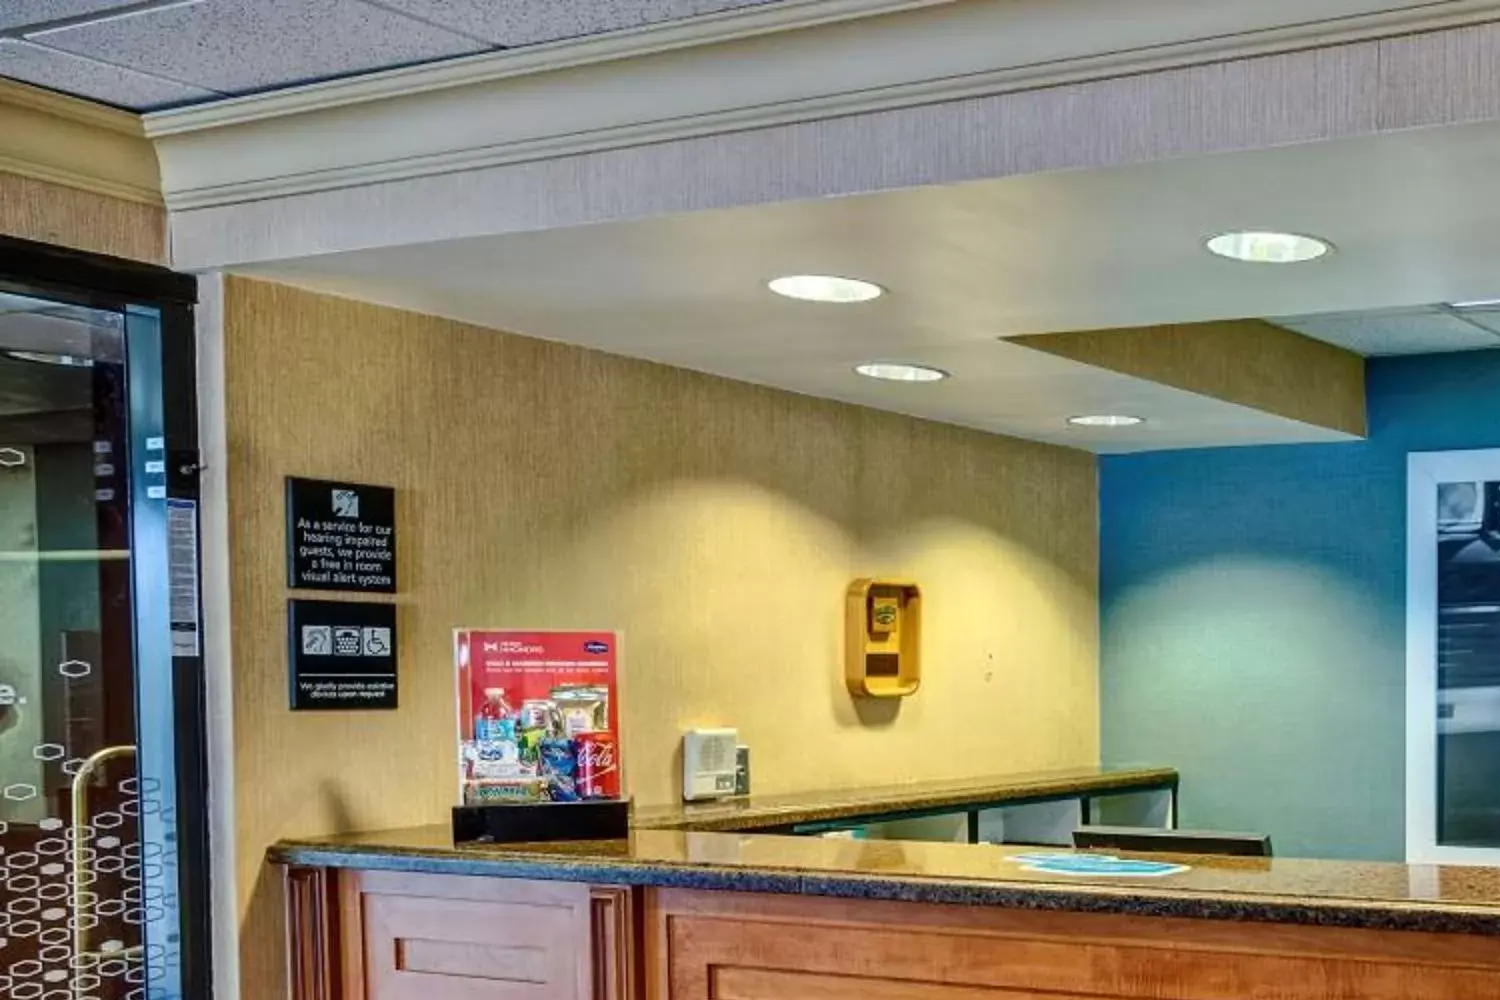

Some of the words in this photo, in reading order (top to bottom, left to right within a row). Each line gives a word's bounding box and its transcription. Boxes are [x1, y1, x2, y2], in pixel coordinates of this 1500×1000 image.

[298, 517, 311, 530] As
[313, 521, 321, 530] a
[322, 520, 357, 533] service
[359, 521, 374, 534] for
[375, 526, 392, 536] our
[303, 530, 343, 547] hearing
[344, 533, 388, 549] impaired
[300, 546, 335, 558] guests,
[338, 548, 353, 559] we
[355, 549, 392, 561] provide
[311, 560, 319, 569] a
[320, 558, 341, 569] free
[343, 559, 354, 571] in
[355, 563, 382, 573] room
[301, 569, 331, 583] visual
[332, 572, 357, 584] alert
[358, 574, 392, 587] system
